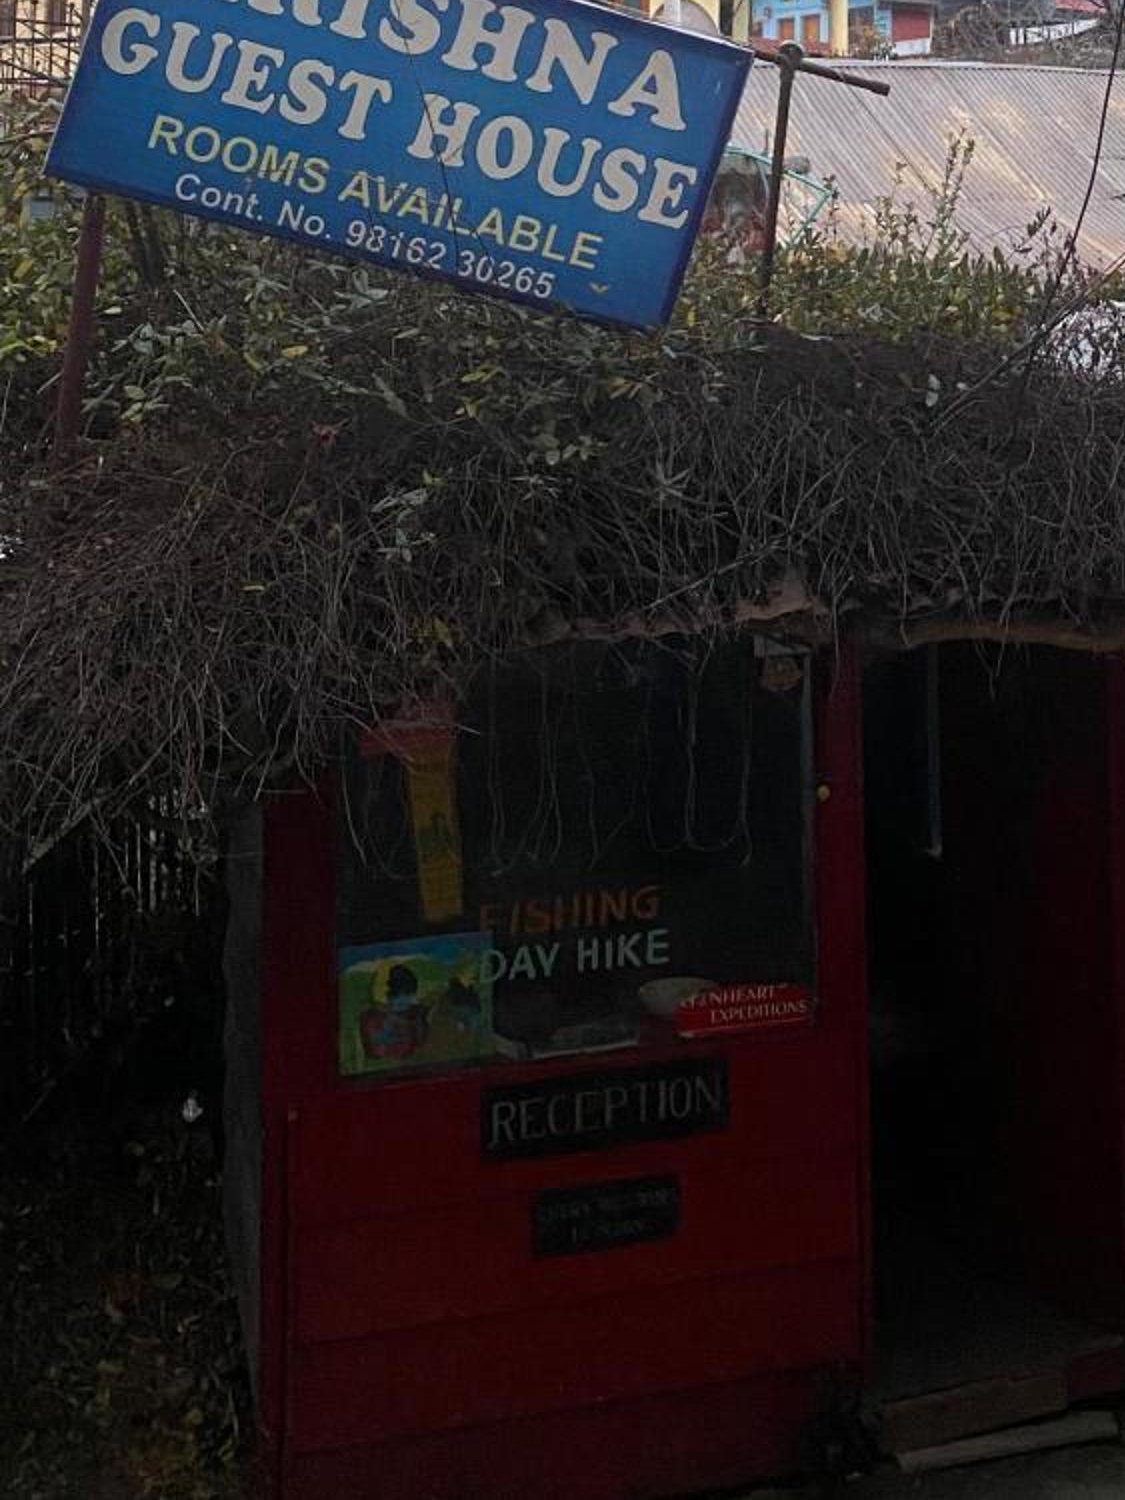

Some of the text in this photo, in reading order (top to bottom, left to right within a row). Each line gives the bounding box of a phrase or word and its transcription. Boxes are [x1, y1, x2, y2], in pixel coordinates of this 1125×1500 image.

[100, 7, 698, 230] GUEST HOUSE
[147, 114, 604, 270] ROOMS AVAILABLE
[175, 173, 556, 299] Cont. No. 98162 30265
[479, 884, 664, 933] FISHING
[481, 927, 671, 981] DAY HIKE
[488, 1072, 722, 1150] RECEPTION
